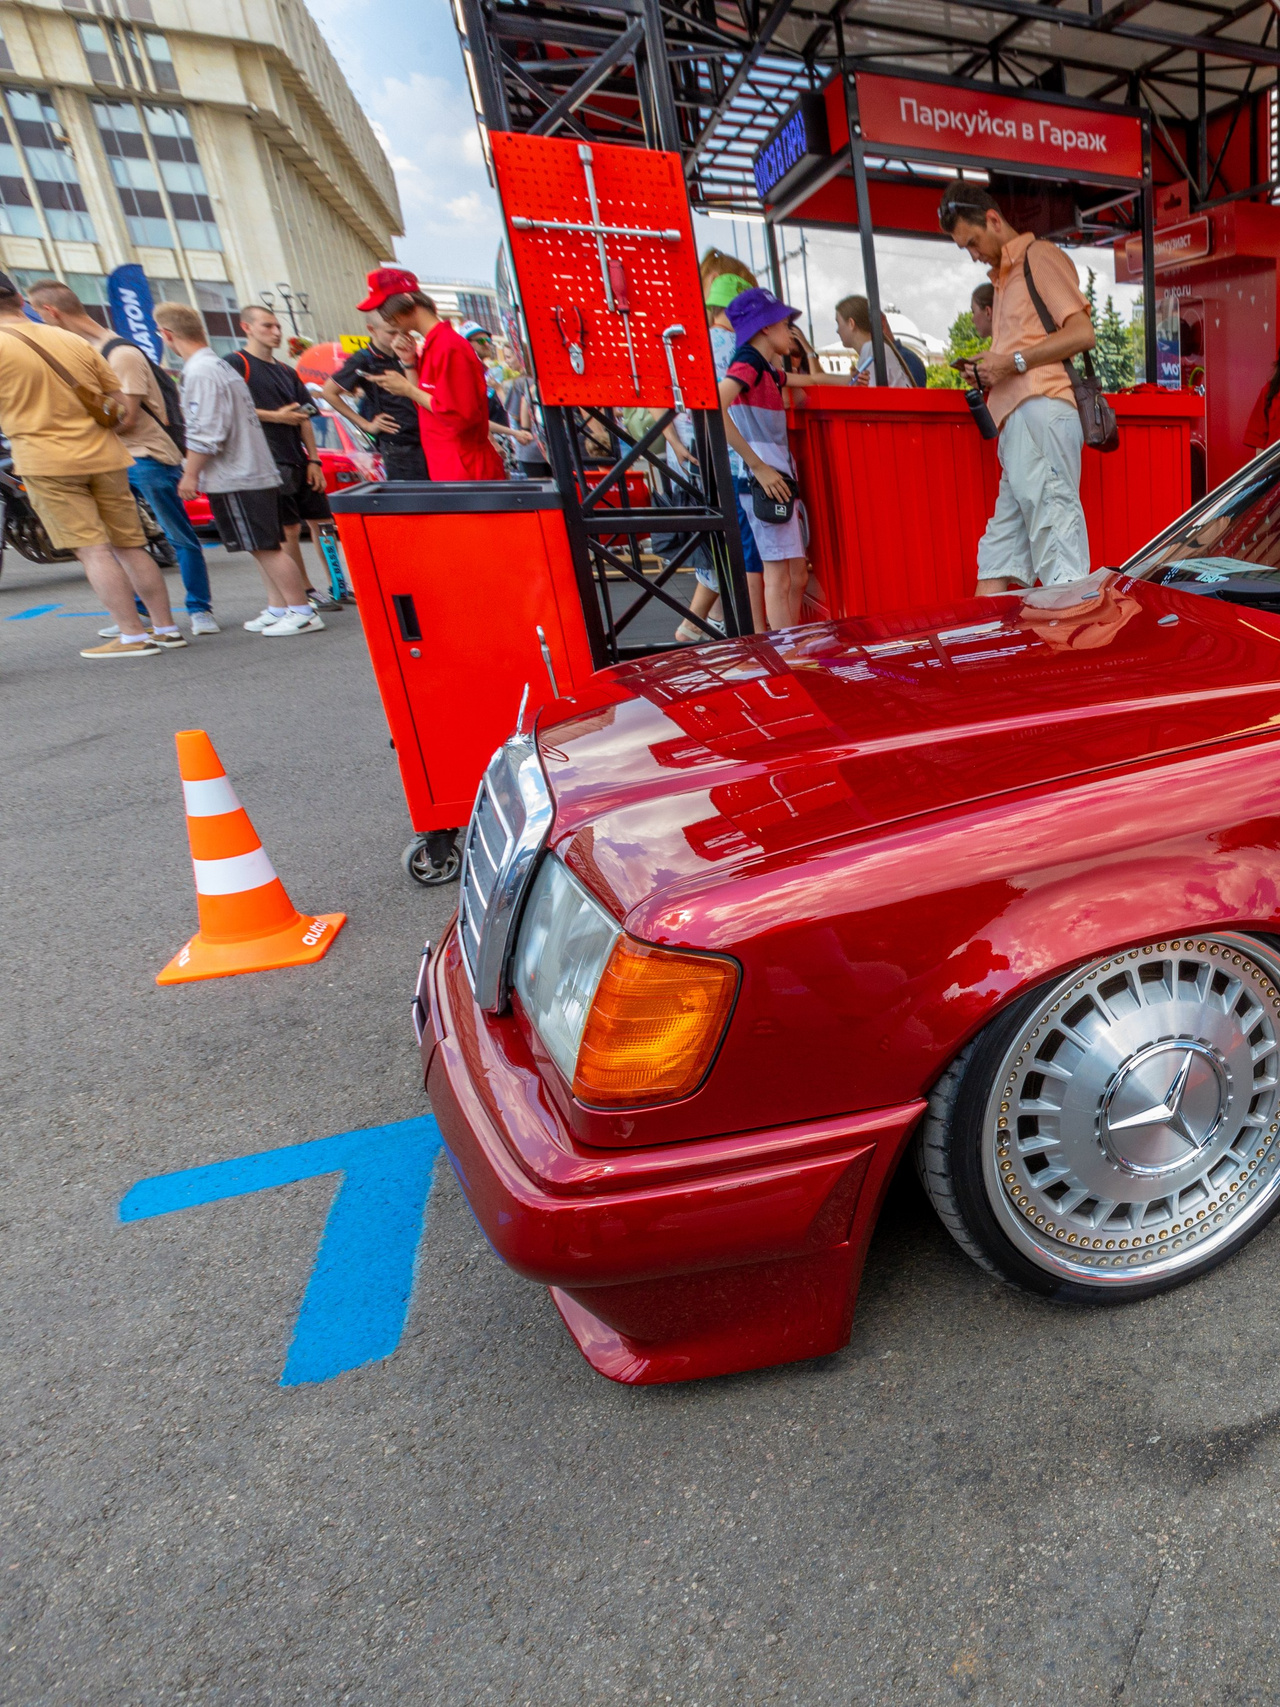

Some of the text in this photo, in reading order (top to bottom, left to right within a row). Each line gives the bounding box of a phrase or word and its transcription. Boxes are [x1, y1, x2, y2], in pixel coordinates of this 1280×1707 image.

[899, 96, 1108, 153] Паркуйся в Гараж
[1163, 285, 1192, 300] auto.ru
